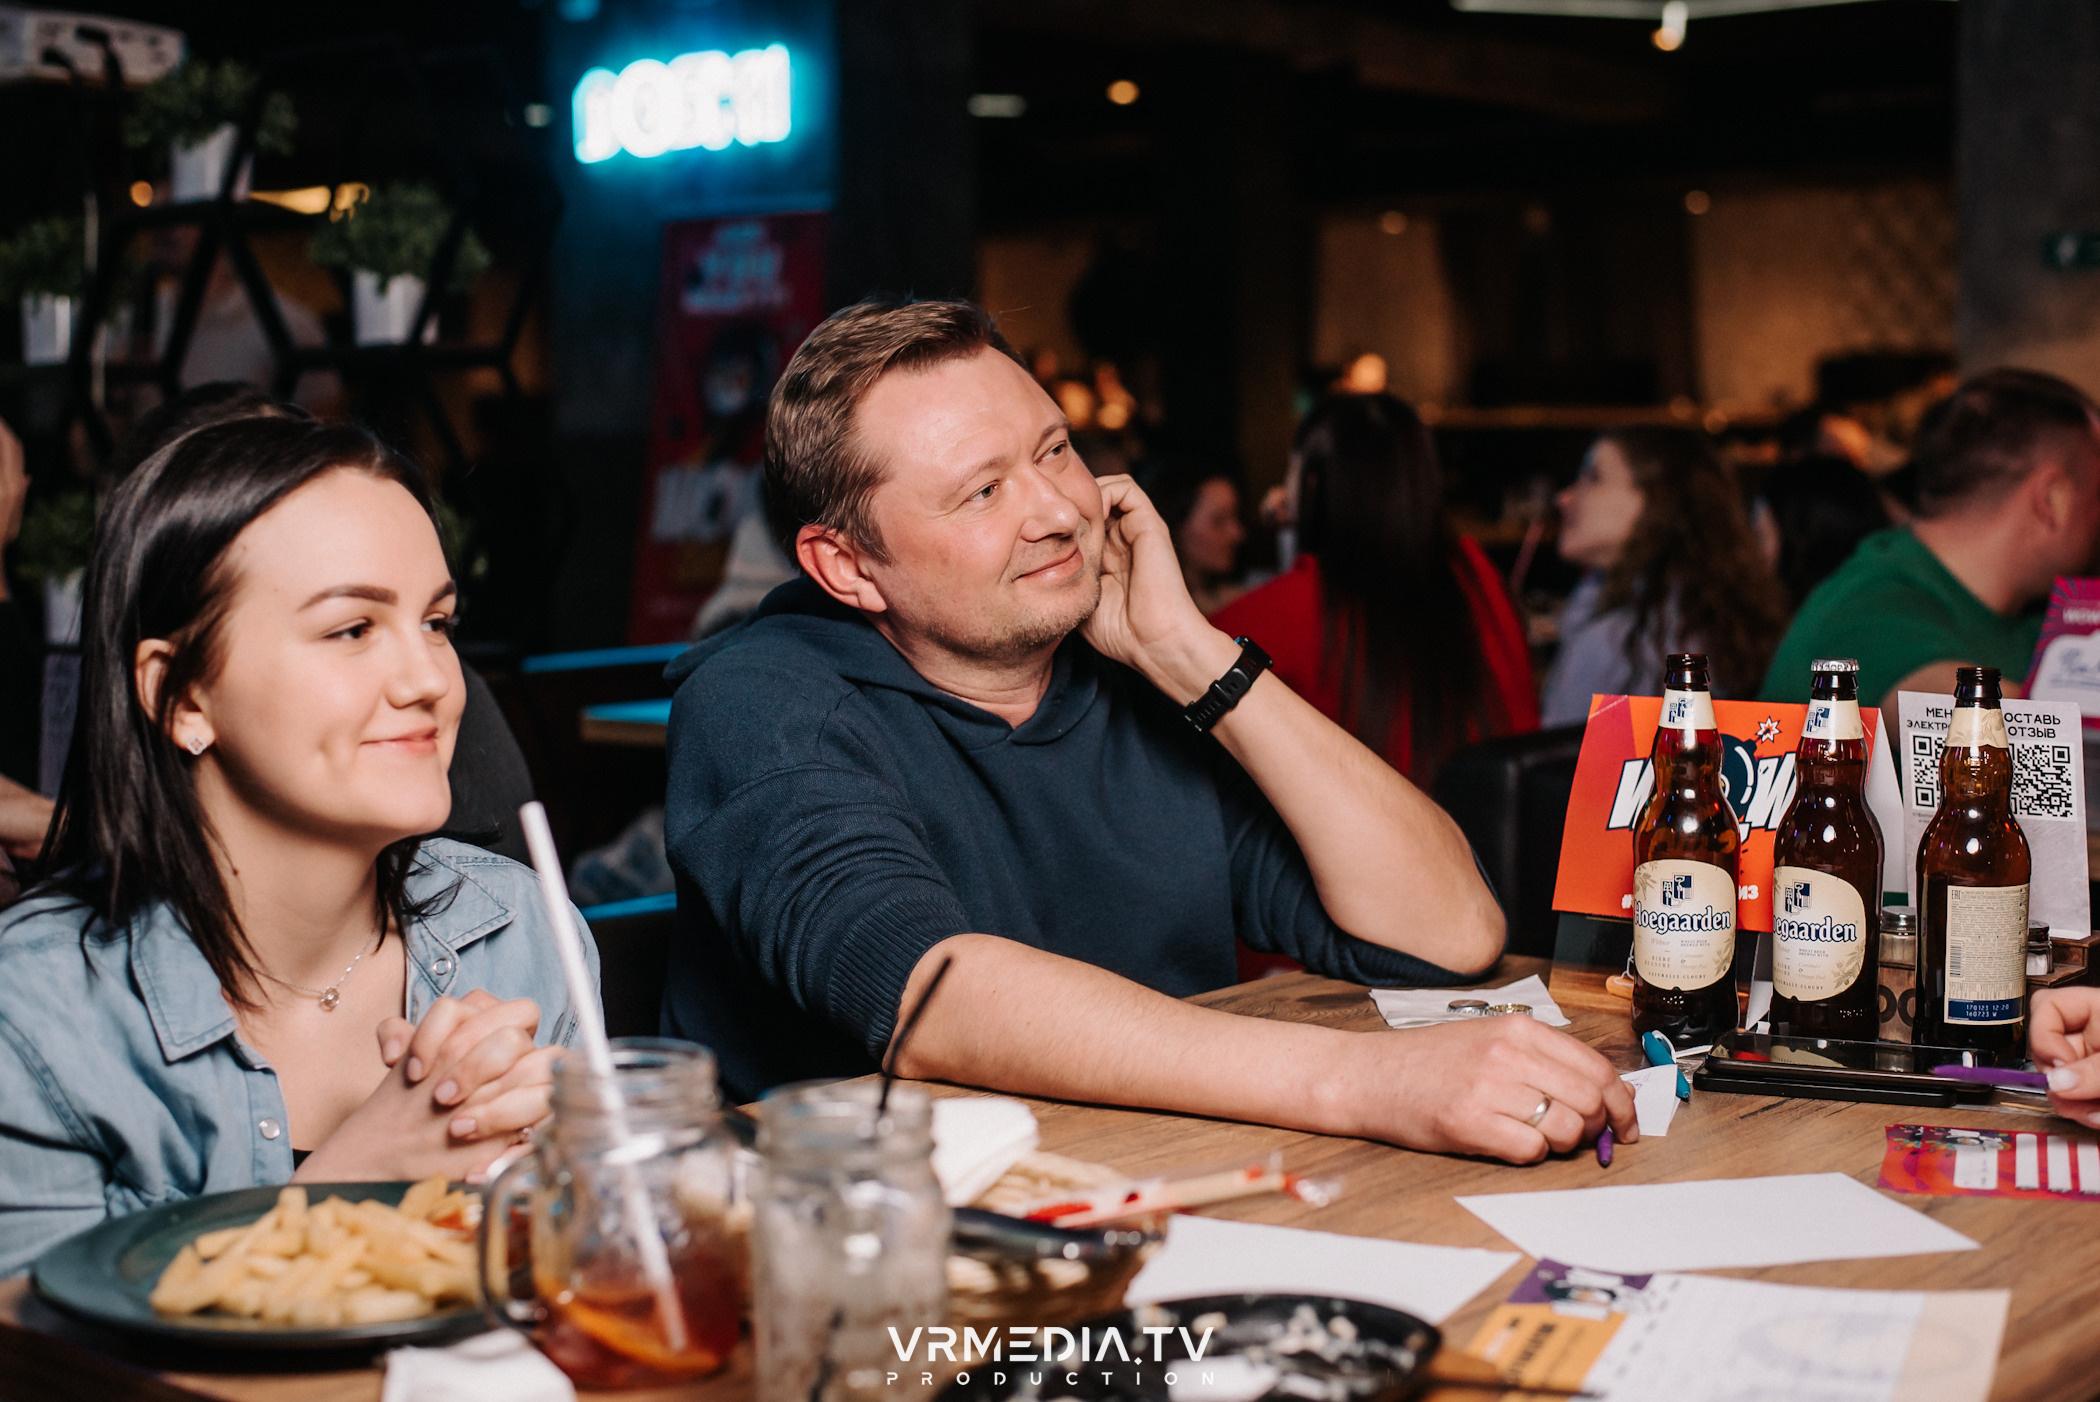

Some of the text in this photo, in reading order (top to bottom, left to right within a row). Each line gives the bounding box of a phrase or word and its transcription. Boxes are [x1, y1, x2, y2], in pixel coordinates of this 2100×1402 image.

[1926, 707, 1953, 718] МЕН
[2003, 712, 2061, 725] ОСТАВЬ
[2008, 726, 2056, 738] ОТЗЫВ
[1634, 899, 1731, 935] Hoegaarden
